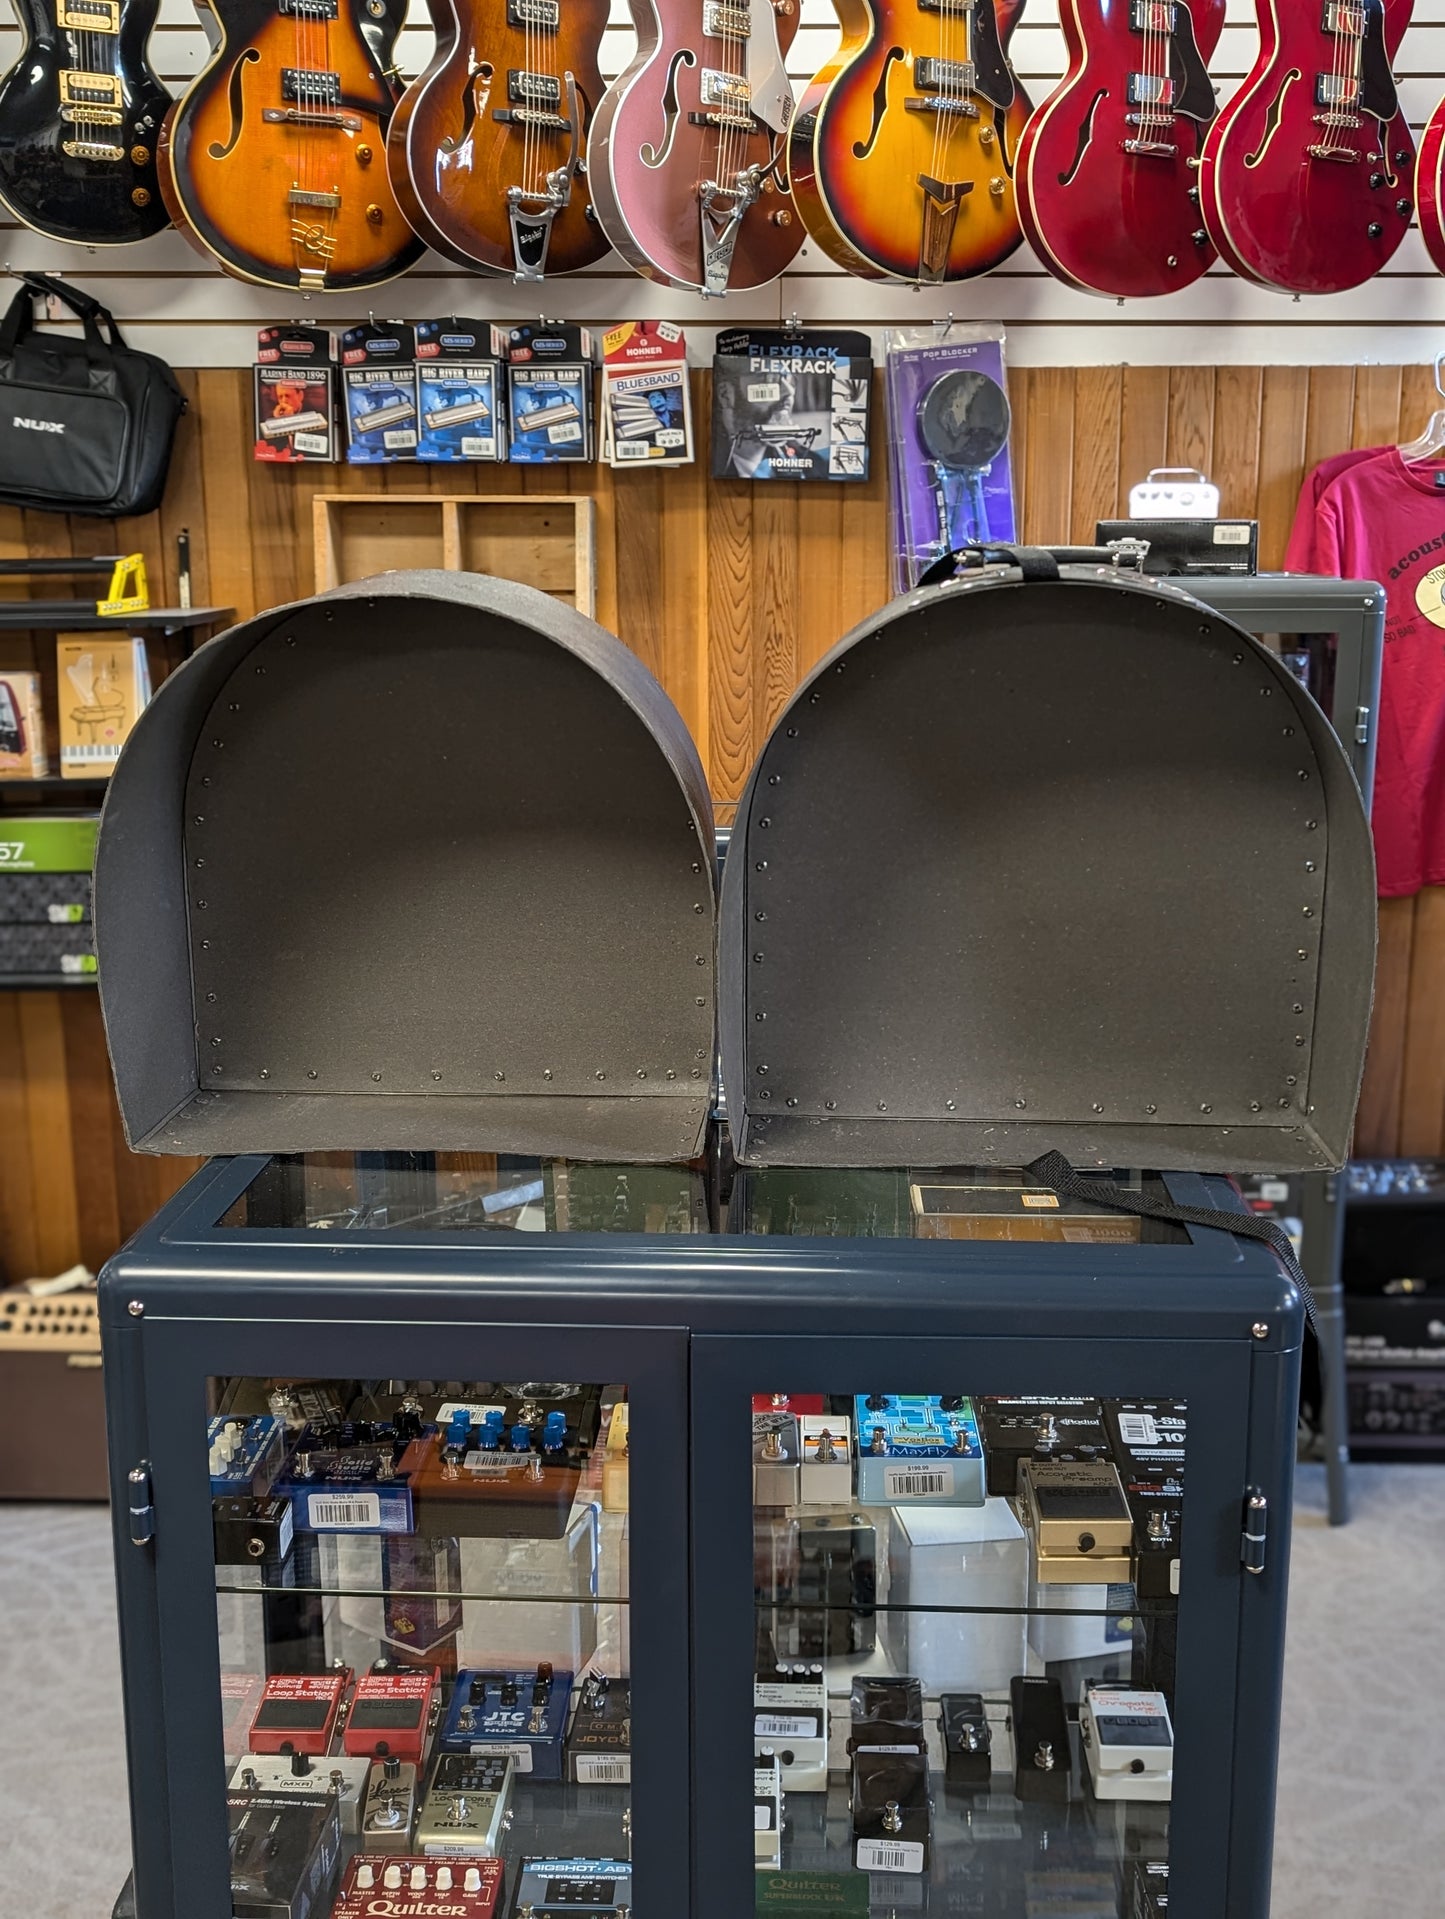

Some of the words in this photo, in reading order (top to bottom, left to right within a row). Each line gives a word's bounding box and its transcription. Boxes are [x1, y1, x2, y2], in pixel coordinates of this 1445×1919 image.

[781, 94, 791, 127] GRETSCH
[417, 344, 436, 352] FREE
[626, 346, 662, 356] HOHNER
[941, 347, 978, 357] BLOCKER
[750, 358, 837, 374] FLEXRACK
[261, 370, 287, 379] MARINE
[288, 370, 306, 380] BAND
[306, 371, 327, 380] 1896
[349, 372, 364, 382] BIG
[365, 371, 390, 382] RIVER
[392, 370, 414, 381] HARP
[422, 367, 437, 379] BIG
[438, 368, 464, 379] RIVER
[466, 368, 490, 379] HARP
[514, 371, 528, 382] BIG
[530, 371, 556, 382] RIVER
[557, 371, 581, 381] HARP
[616, 371, 681, 391] BLUESBAND
[768, 458, 813, 468] HOHNER
[1384, 632, 1396, 643] SO
[892, 1447, 950, 1457] MayFly
[267, 1689, 293, 1697] Loop
[358, 1687, 385, 1695] Loop
[487, 1712, 525, 1720] JTC
[301, 1800, 327, 1808] System
[530, 1864, 593, 1872] BIGSHOT
